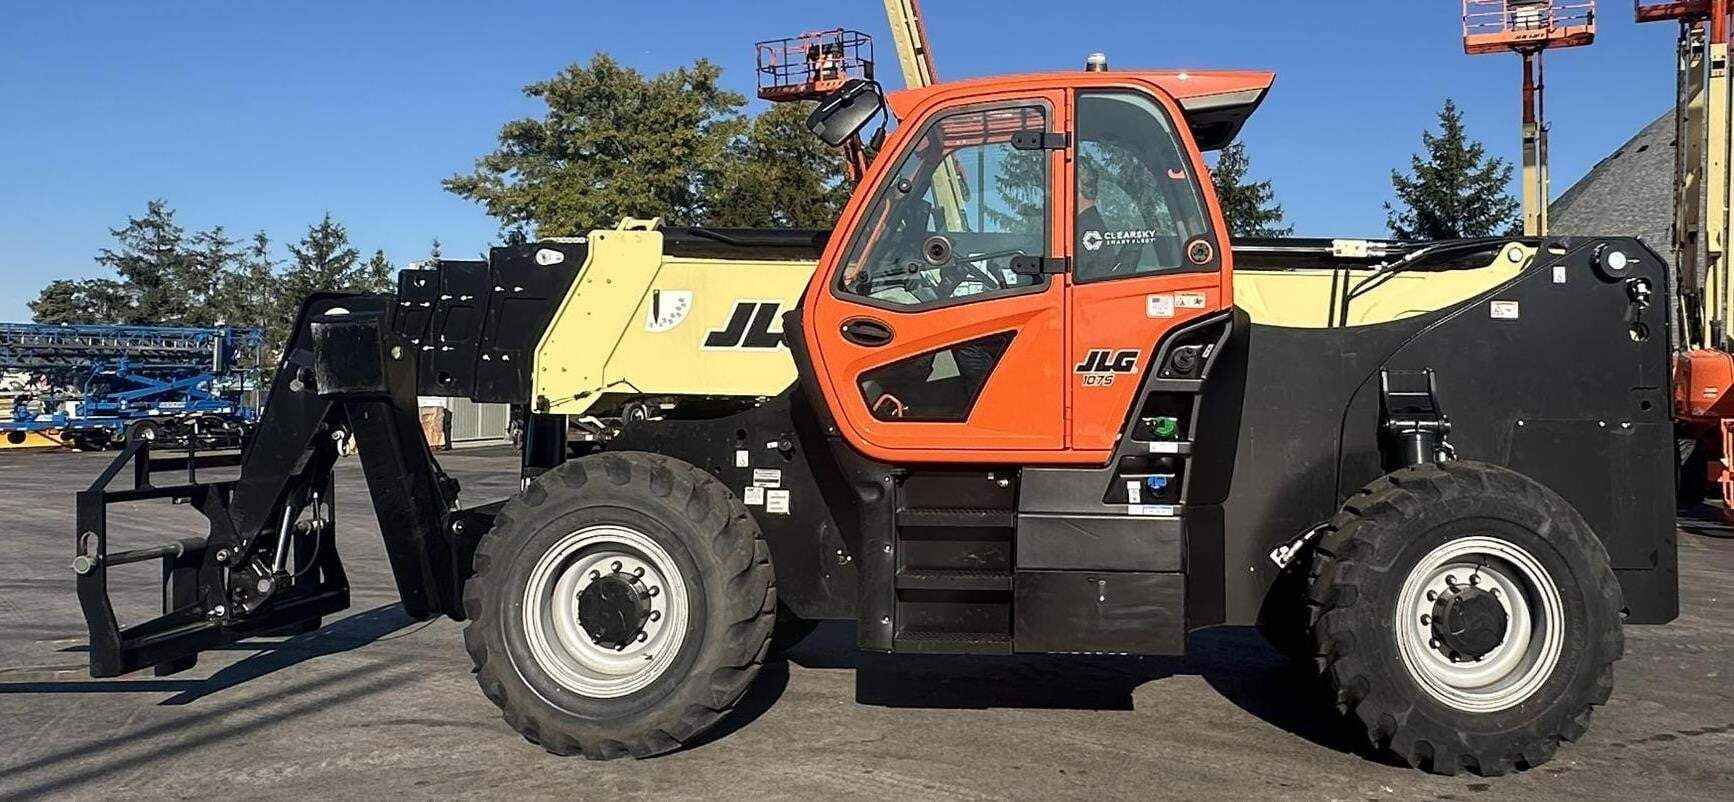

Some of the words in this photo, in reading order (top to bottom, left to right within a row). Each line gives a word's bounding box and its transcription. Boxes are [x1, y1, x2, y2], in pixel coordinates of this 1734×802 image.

[1104, 230, 1156, 239] CLEARSKY
[704, 302, 785, 347] JL
[1075, 350, 1139, 372] JLG
[1083, 375, 1114, 385] 1075
